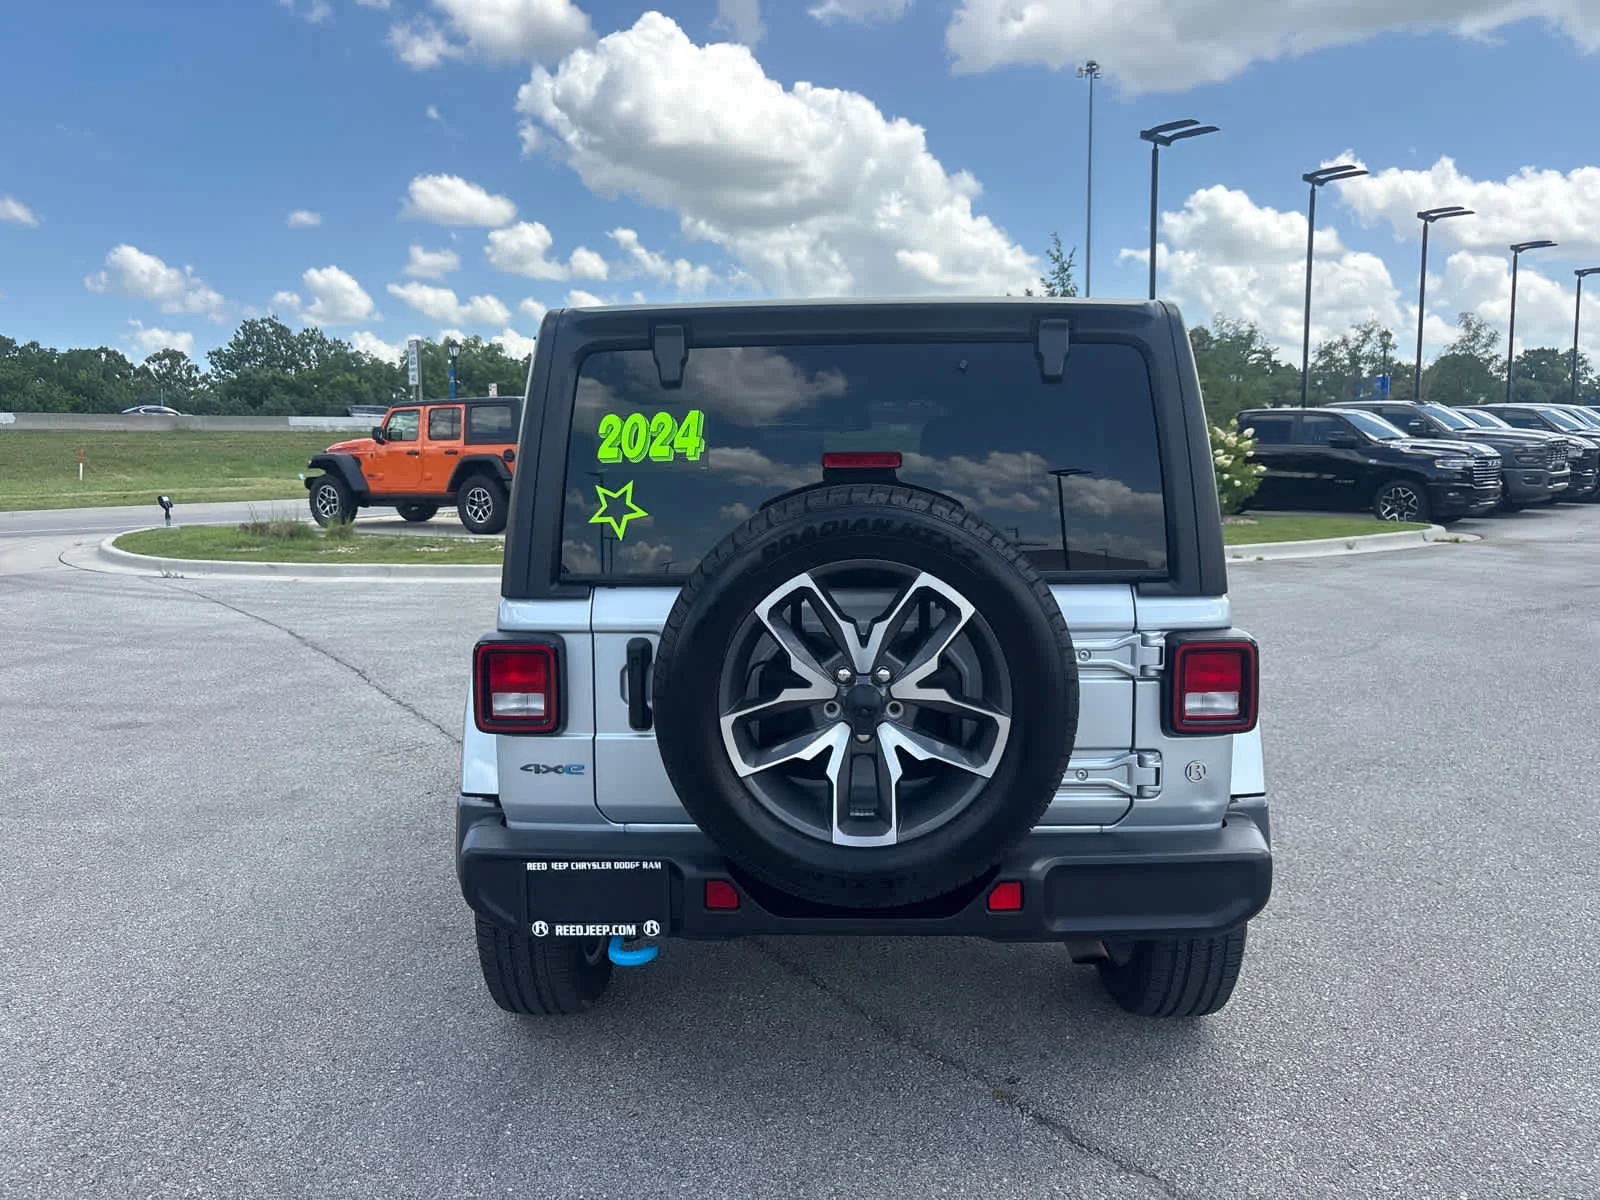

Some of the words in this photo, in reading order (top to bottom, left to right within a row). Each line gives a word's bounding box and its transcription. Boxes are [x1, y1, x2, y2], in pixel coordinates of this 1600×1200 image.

[597, 409, 705, 463] 2024
[526, 862, 548, 871] REED
[570, 861, 612, 870] CHRYSLER
[642, 861, 662, 870] RAM
[555, 924, 636, 937] REEDJEEP.COM
